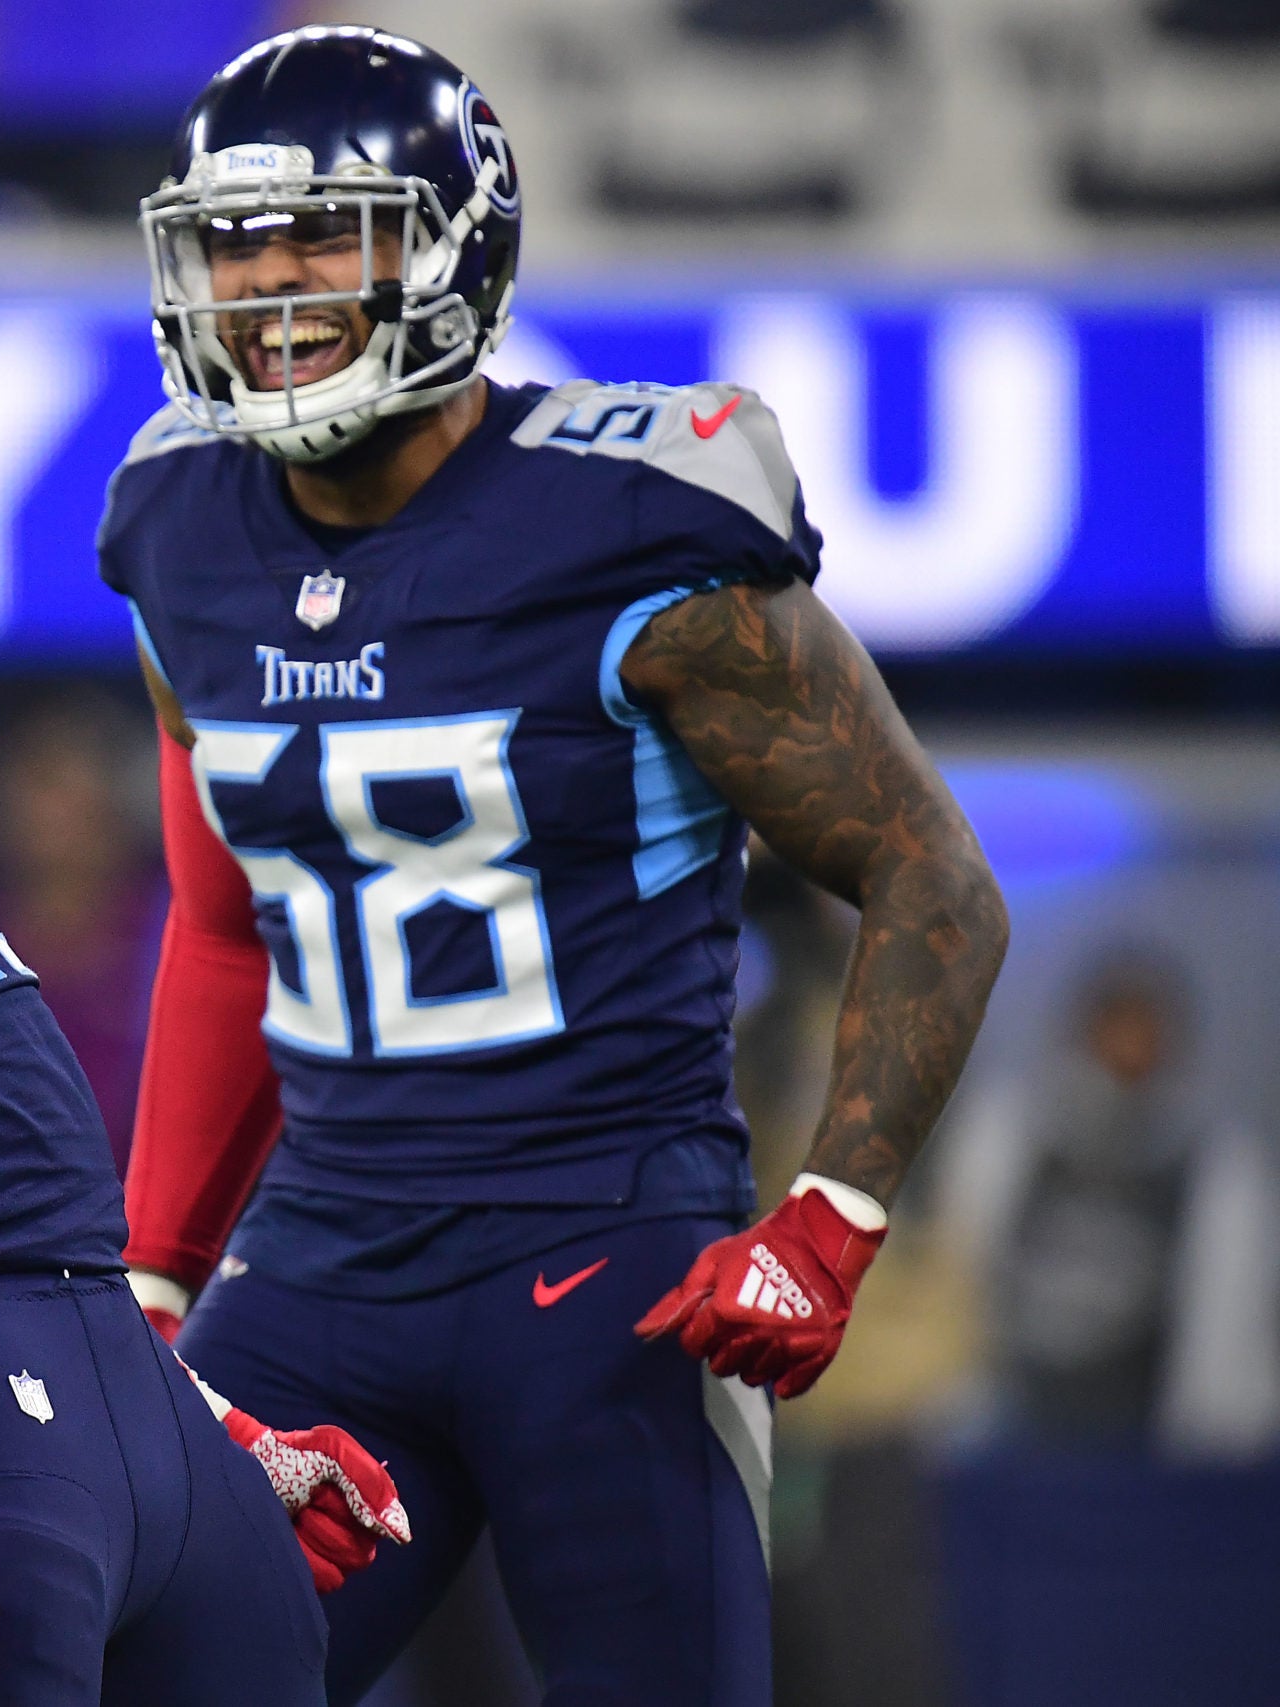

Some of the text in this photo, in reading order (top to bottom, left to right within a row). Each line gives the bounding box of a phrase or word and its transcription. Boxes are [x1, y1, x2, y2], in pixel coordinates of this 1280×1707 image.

[226, 149, 278, 170] TITANS
[255, 641, 385, 706] TITANS
[184, 706, 566, 1058] 58
[750, 1242, 813, 1319] adidas
